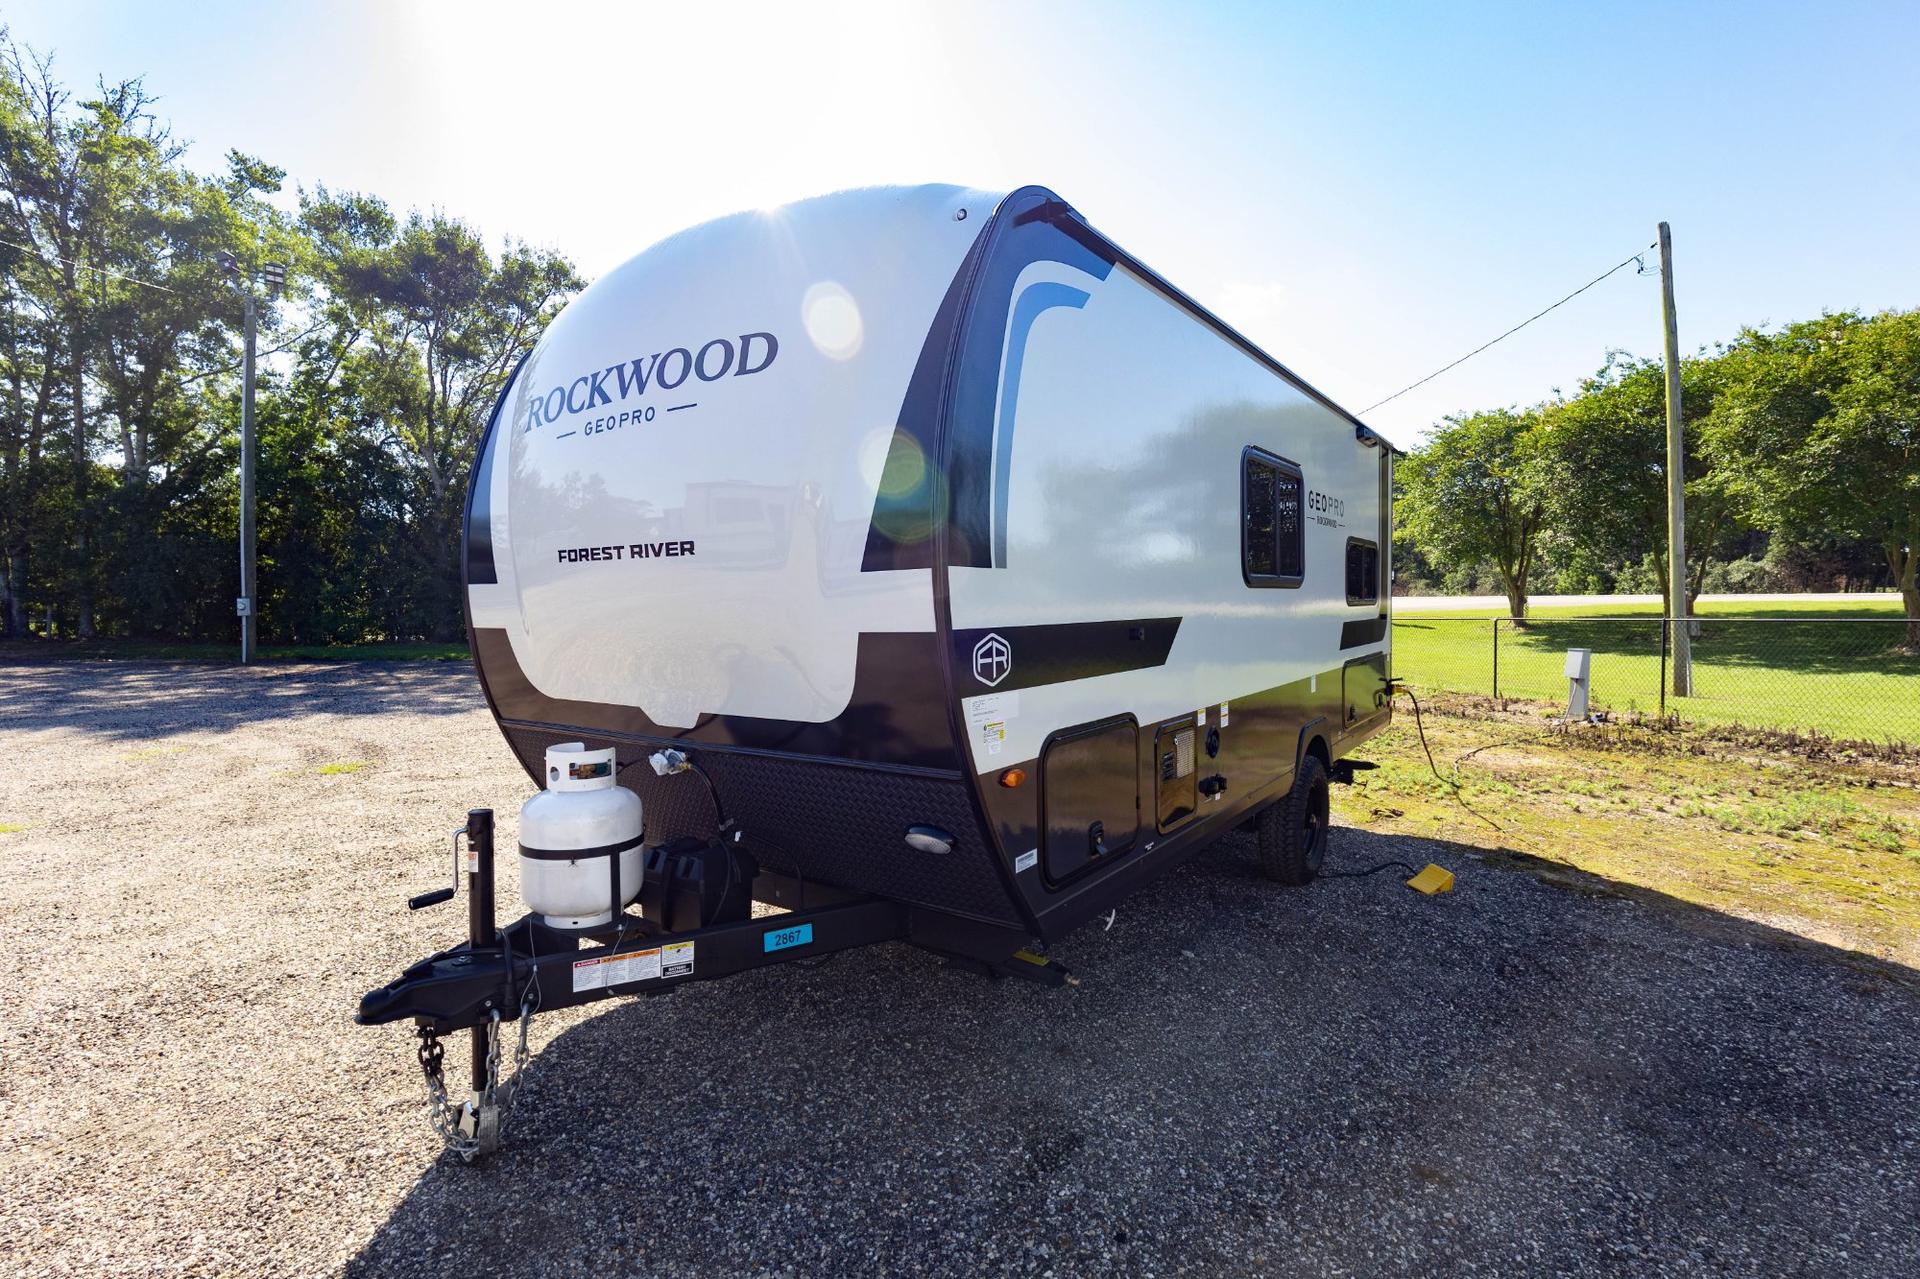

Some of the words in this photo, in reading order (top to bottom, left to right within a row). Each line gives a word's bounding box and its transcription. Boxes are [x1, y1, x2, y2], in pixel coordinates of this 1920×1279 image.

[524, 332, 779, 434] ROCKWOOD
[584, 406, 656, 436] GEOPRO
[1308, 490, 1345, 517] GEOPRO
[558, 545, 625, 563] FOREST
[630, 540, 696, 559] RIVER
[775, 930, 801, 947] 2867
